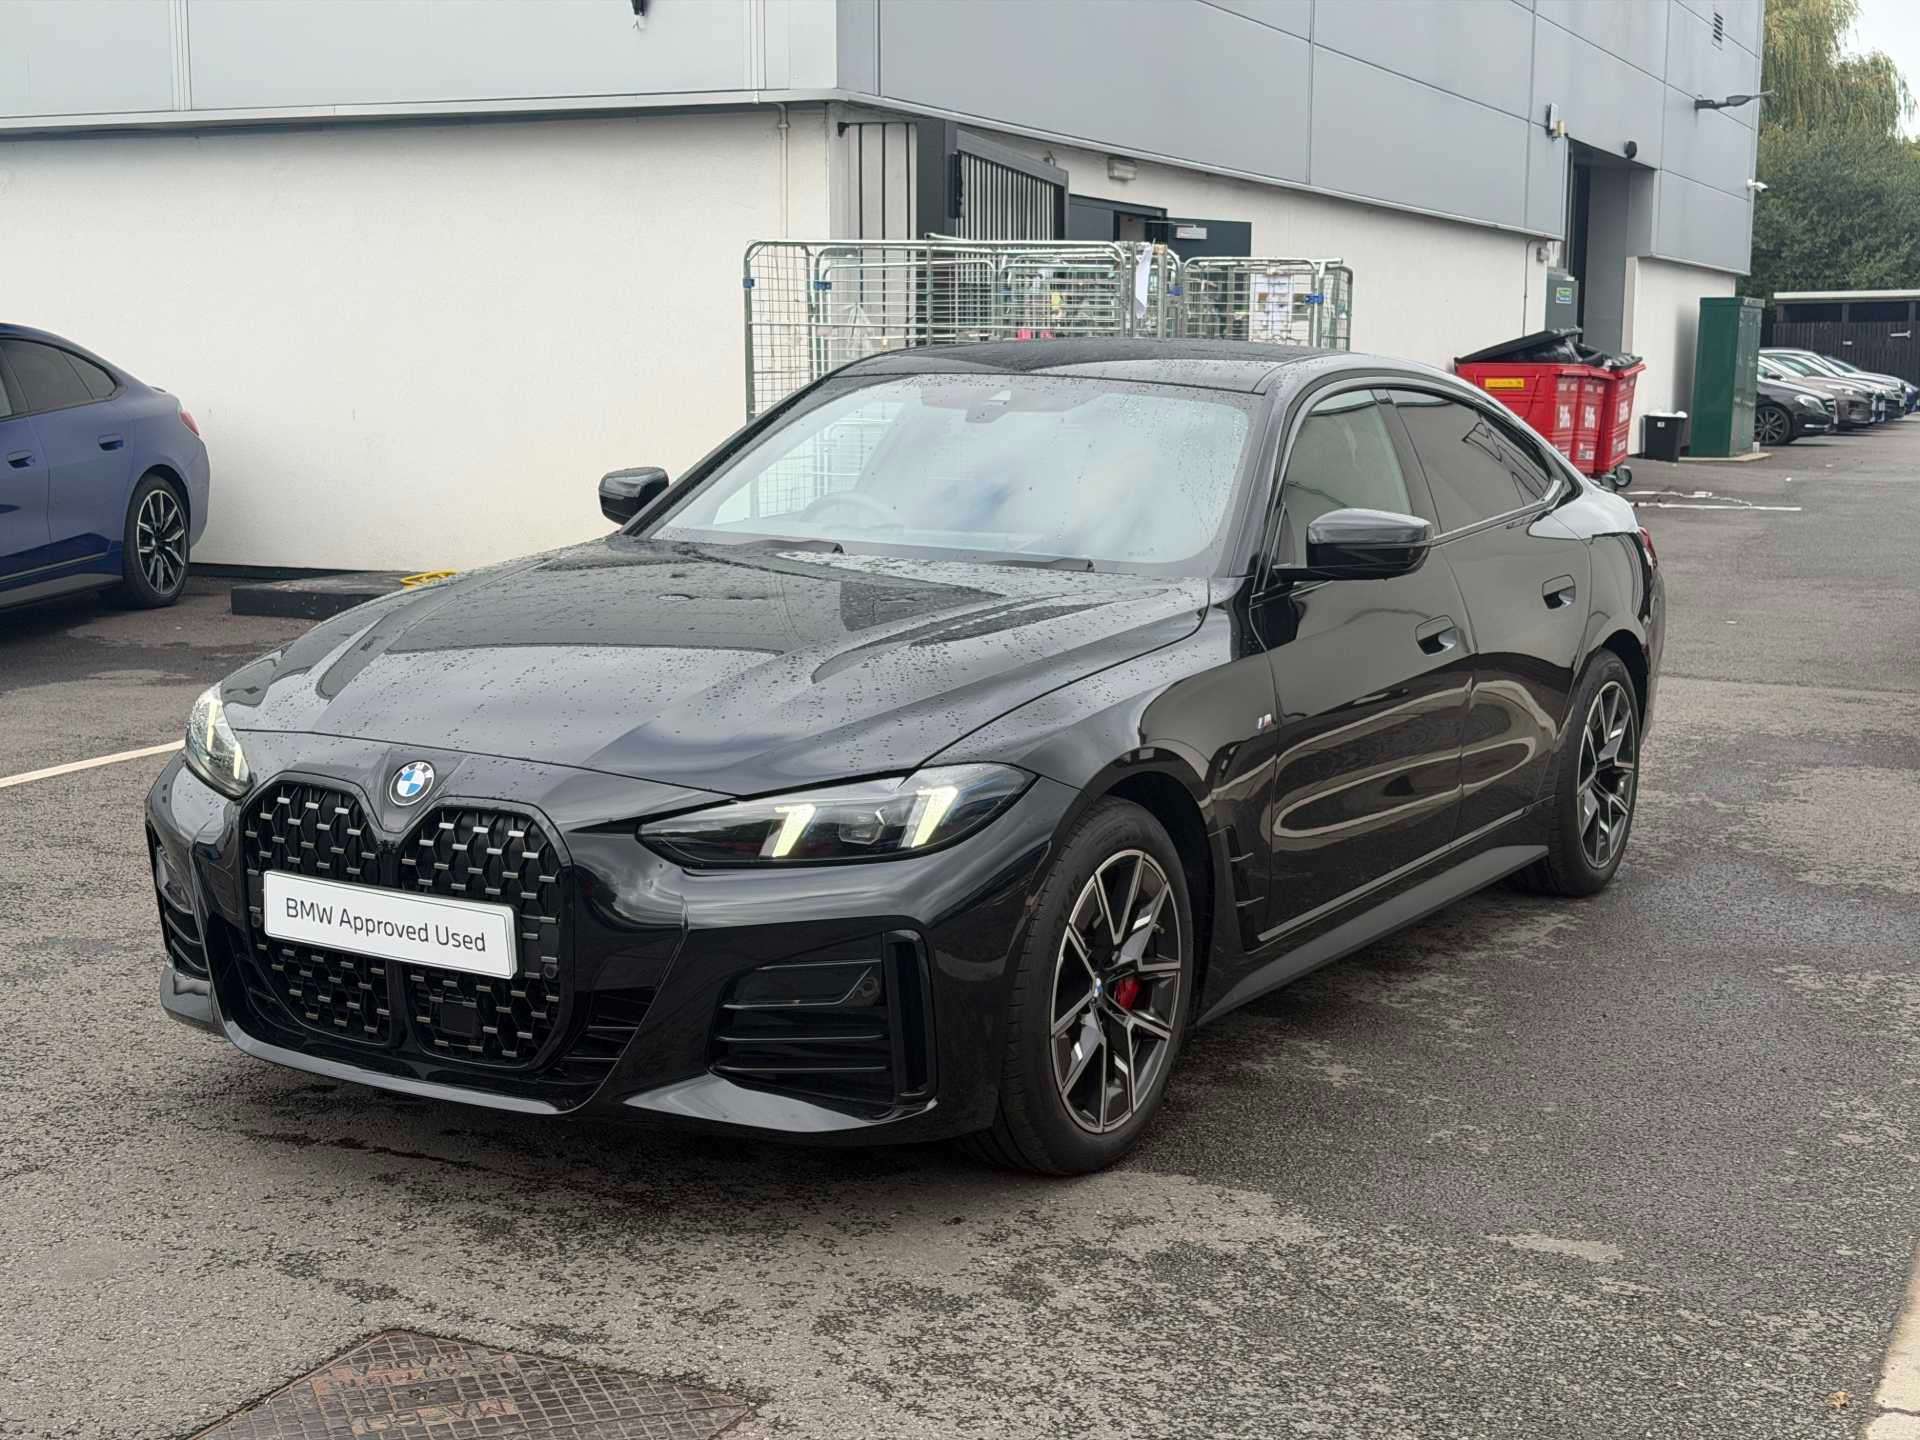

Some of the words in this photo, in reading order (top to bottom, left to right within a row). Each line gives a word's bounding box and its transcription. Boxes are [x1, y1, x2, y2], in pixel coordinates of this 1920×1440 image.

[286, 897, 333, 925] BMW
[339, 908, 429, 942] Approved
[435, 924, 486, 952] Used
